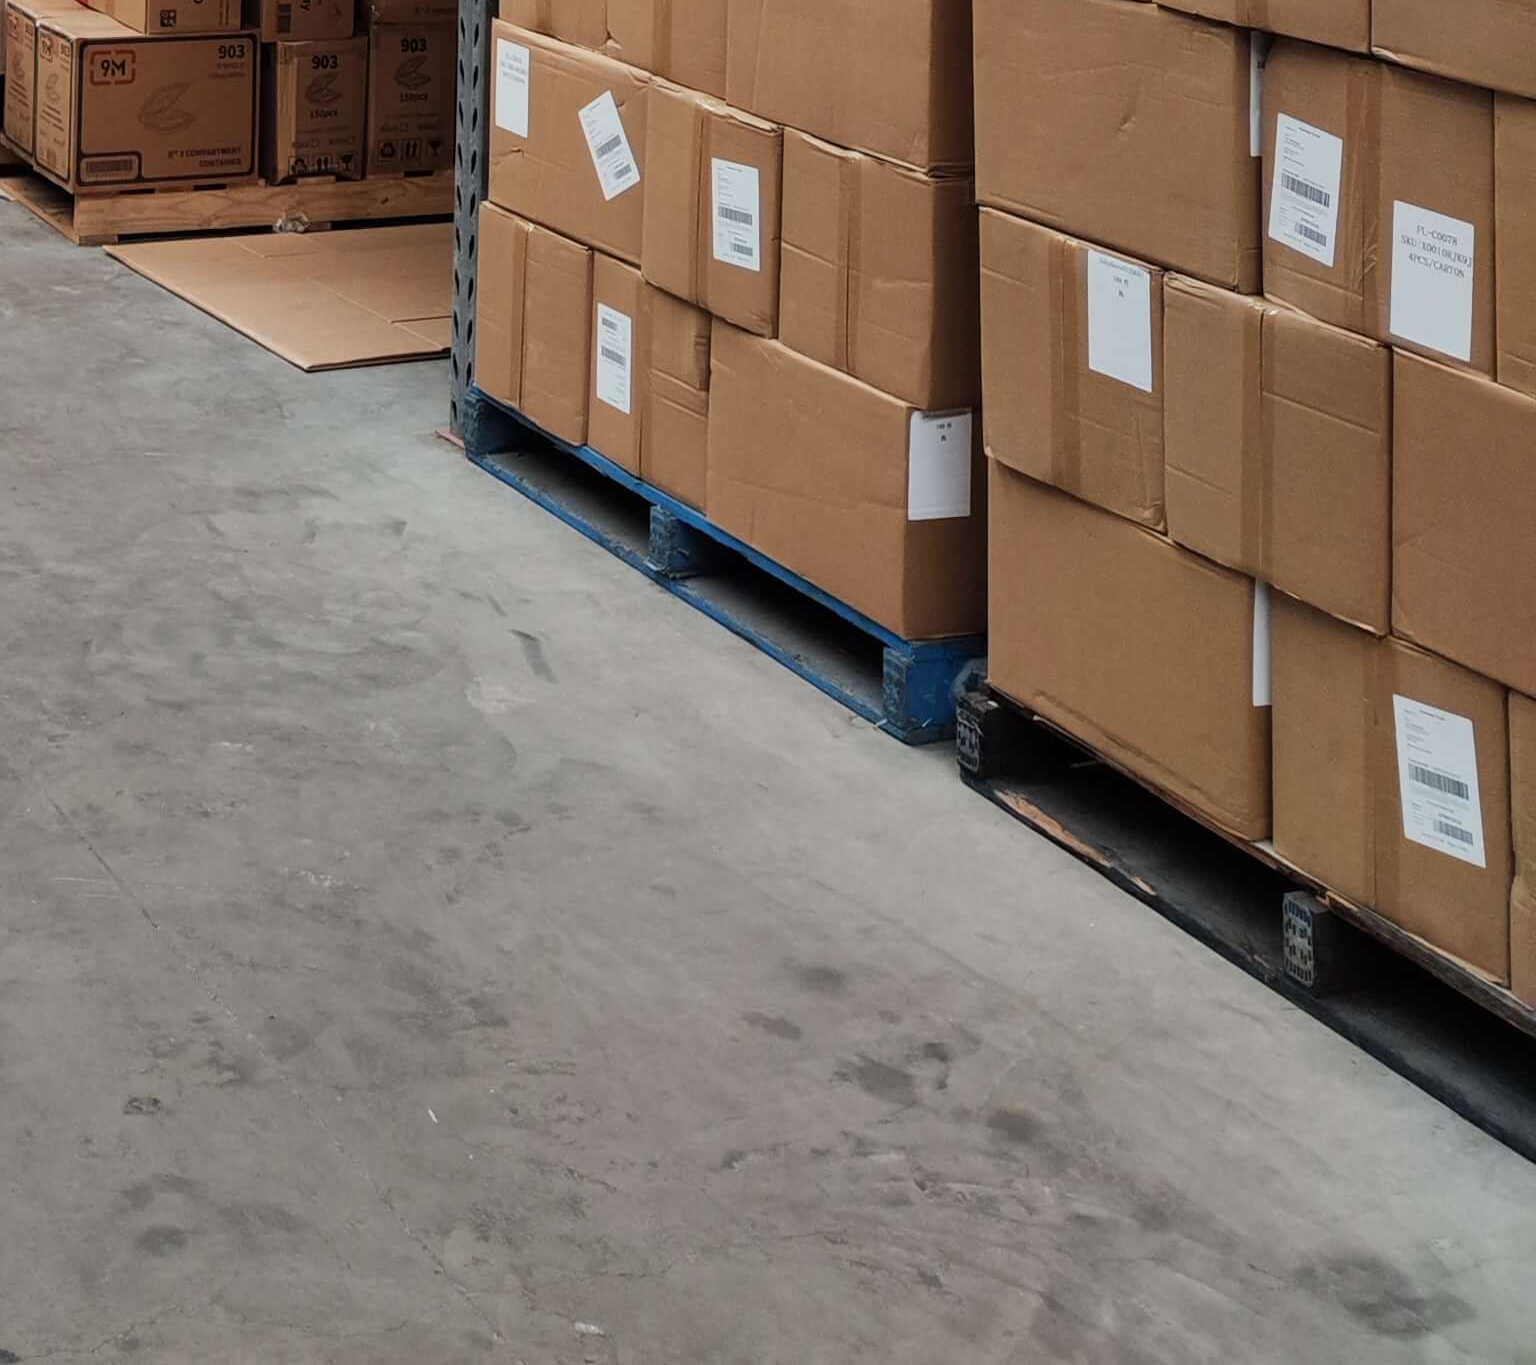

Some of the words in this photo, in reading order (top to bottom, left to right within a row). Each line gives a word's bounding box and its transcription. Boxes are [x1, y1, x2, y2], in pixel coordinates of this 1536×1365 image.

[217, 43, 245, 60] 903
[400, 38, 428, 53] 903
[99, 58, 127, 77] 9M
[311, 54, 339, 69] 903
